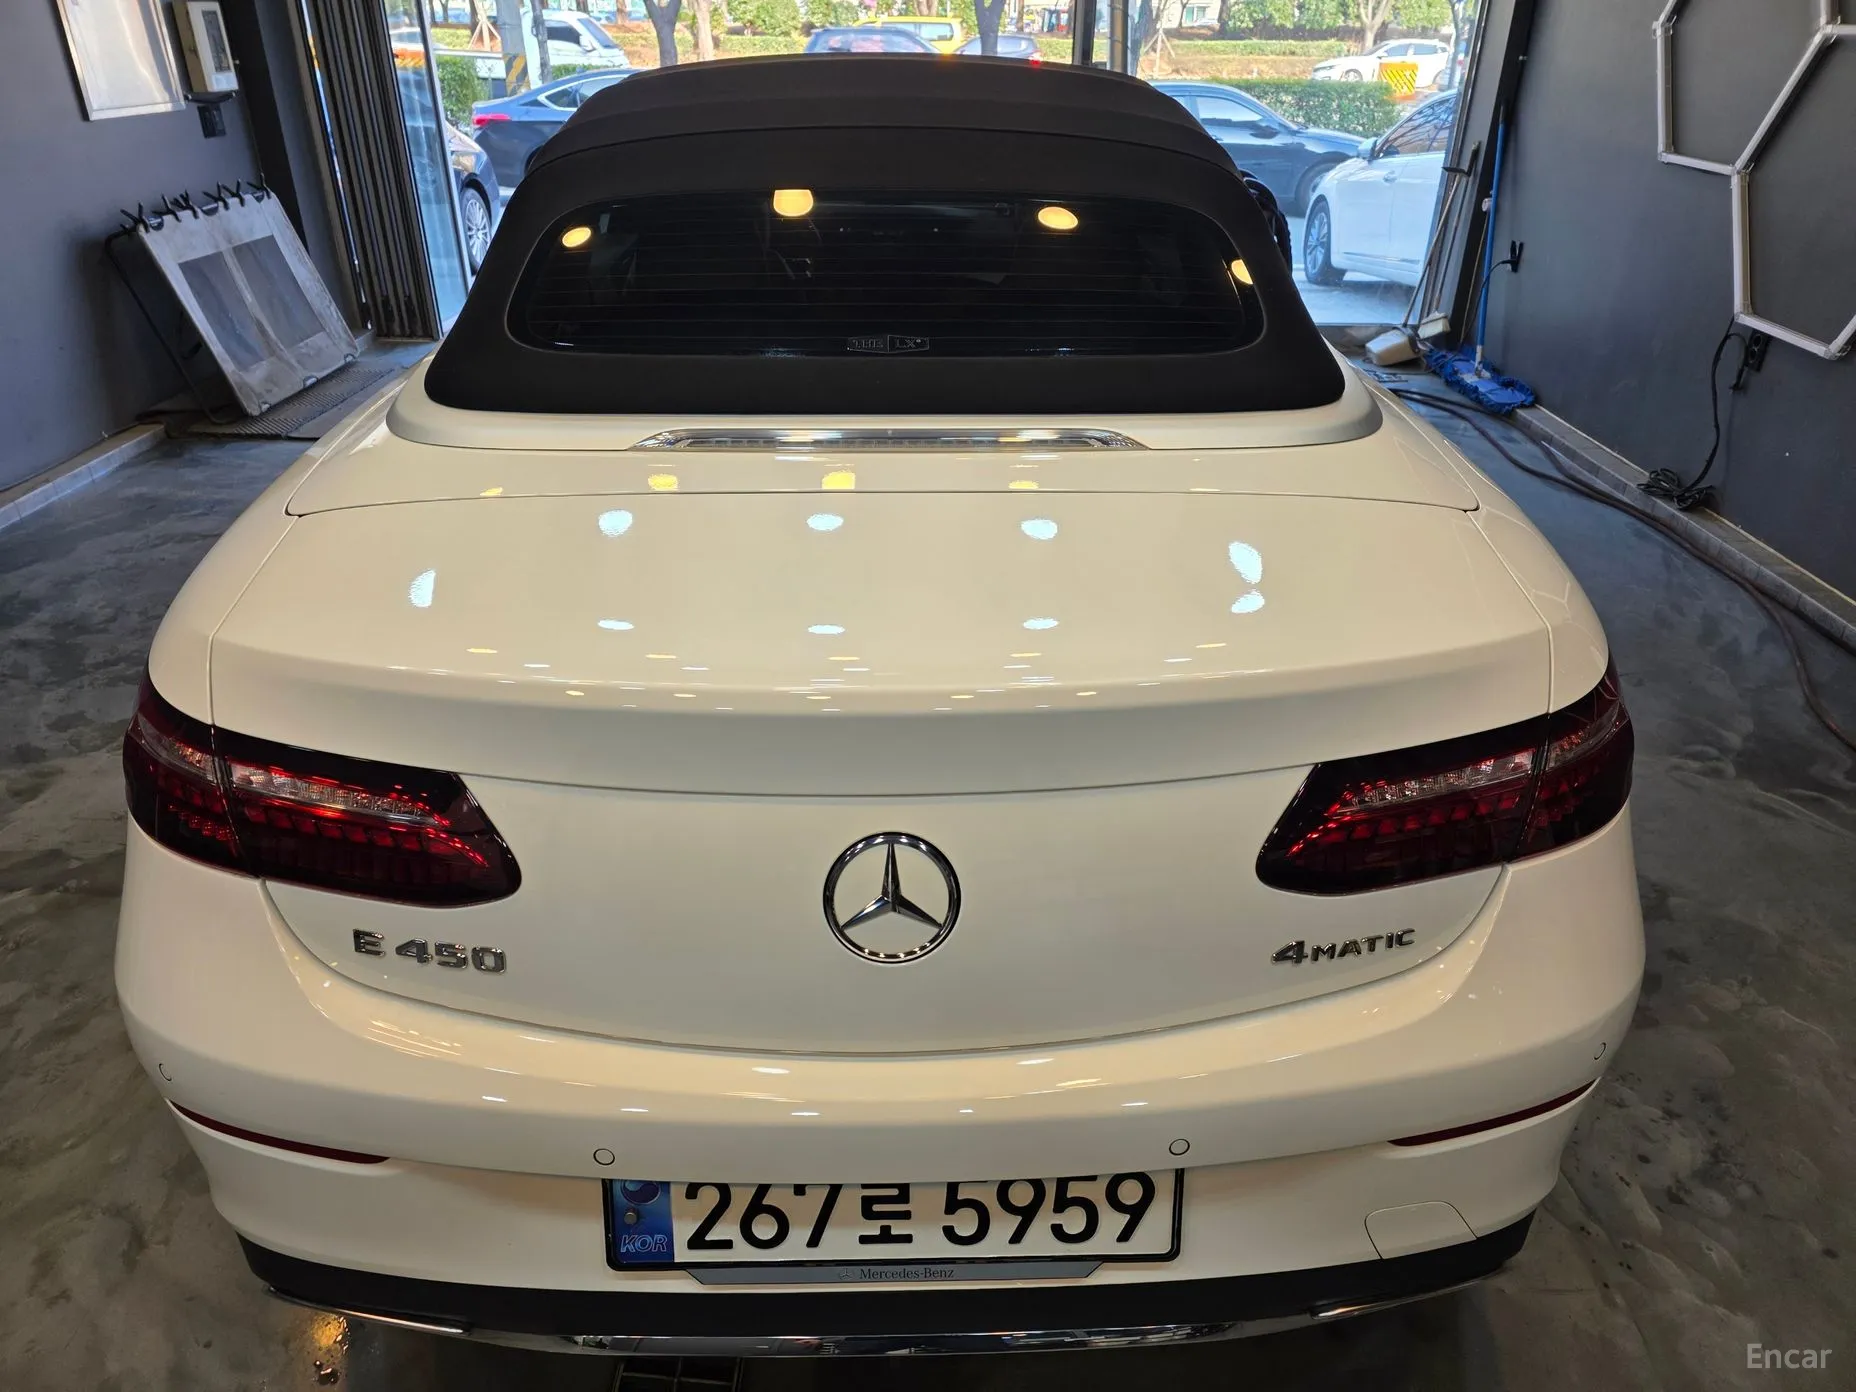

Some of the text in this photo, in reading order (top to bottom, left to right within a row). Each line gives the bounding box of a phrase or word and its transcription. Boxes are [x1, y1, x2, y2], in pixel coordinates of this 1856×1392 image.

[352, 928, 507, 974] E 450
[1271, 927, 1416, 965] 4MATIC
[684, 1171, 1156, 1250] 267로 5959
[620, 1234, 668, 1253] KOR
[859, 1267, 955, 1280] Mercedes-Benz
